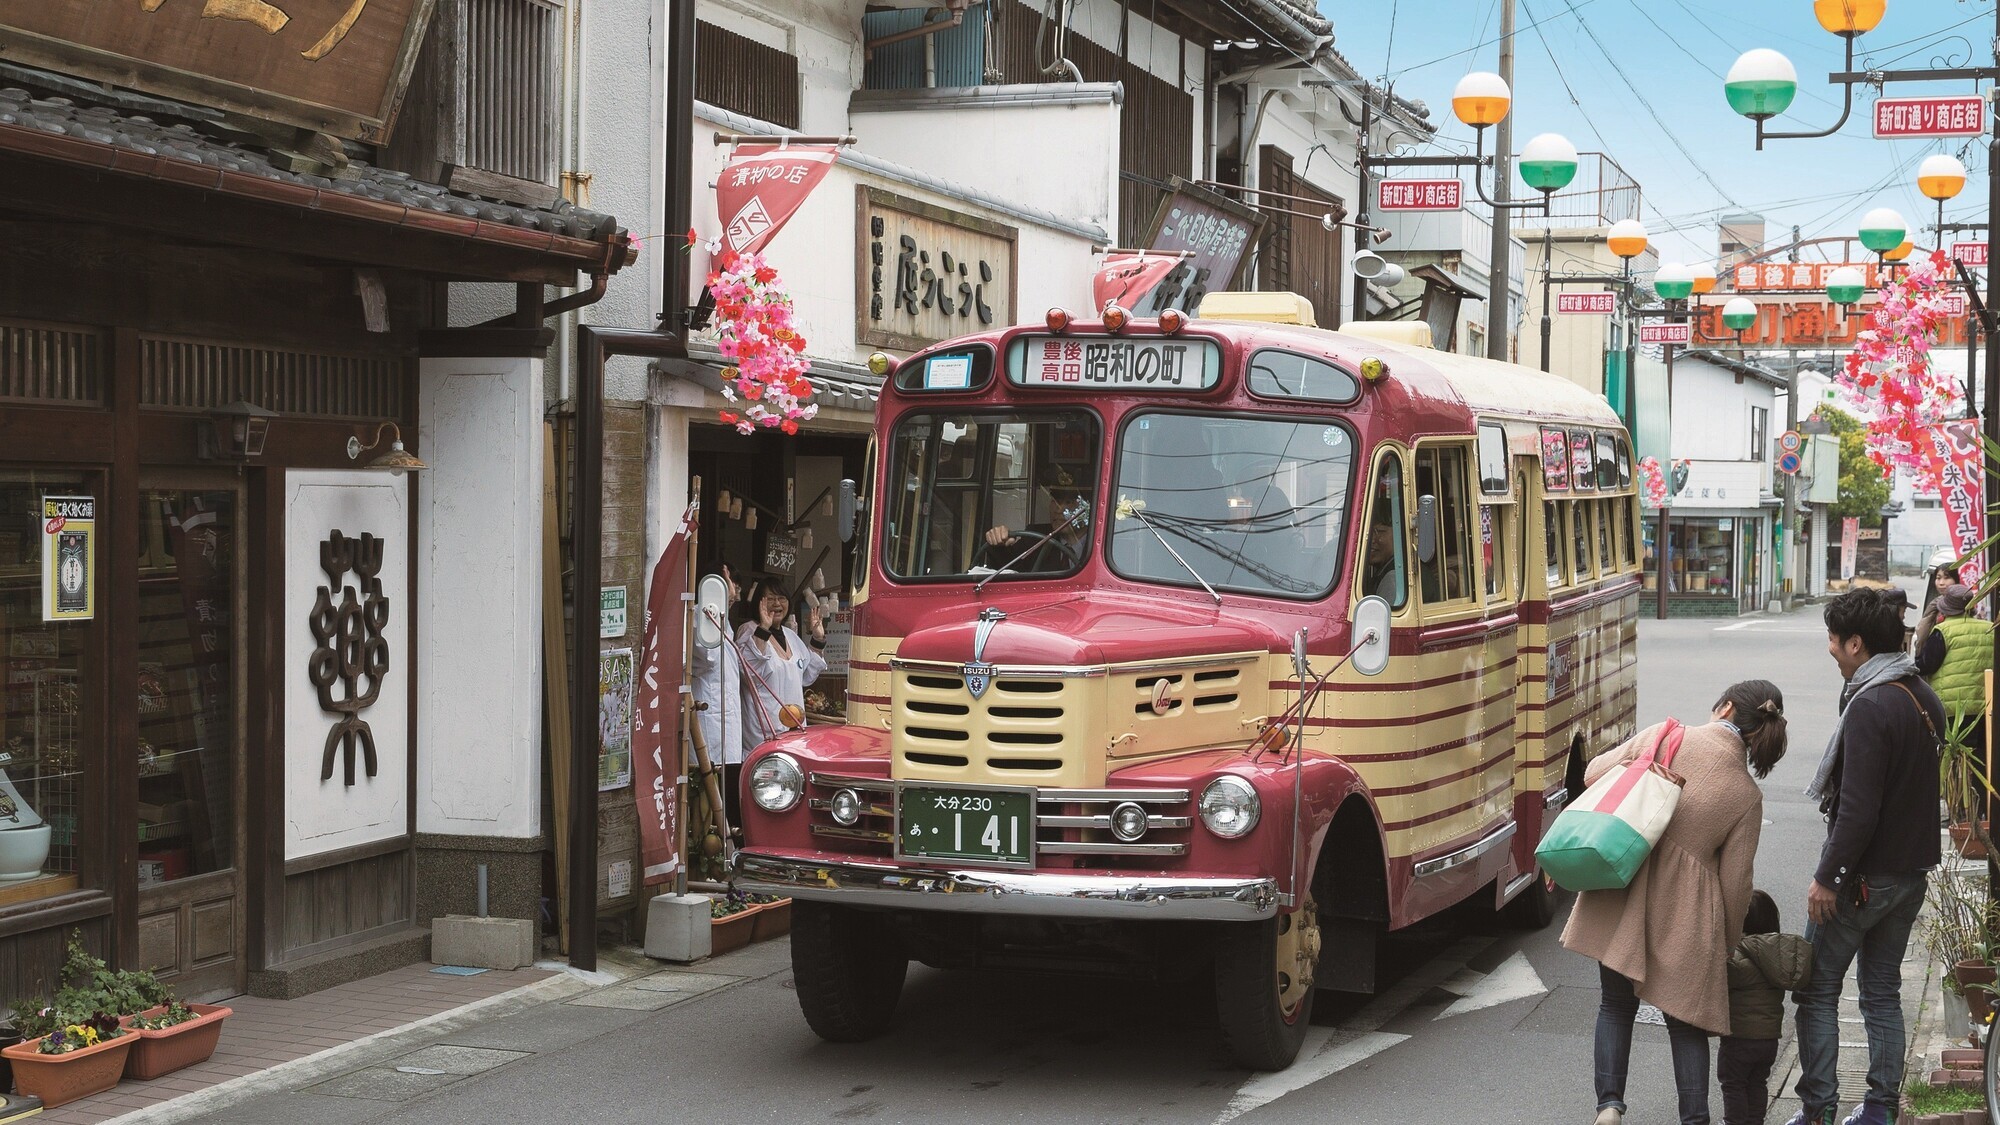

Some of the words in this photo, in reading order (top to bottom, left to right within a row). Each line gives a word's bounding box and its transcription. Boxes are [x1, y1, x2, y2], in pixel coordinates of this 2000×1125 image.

[1879, 102, 1979, 131] 新町通り商店街
[732, 165, 808, 187] 漬物の店
[1382, 184, 1458, 207] 新町通り商店街
[1559, 294, 1613, 311] 新町通り商店街
[1042, 341, 1083, 361] 豊後
[1041, 362, 1082, 382] 高田
[1085, 342, 1188, 384] 昭和の町
[1784, 437, 1797, 447] 30
[963, 667, 990, 675] ISUZU
